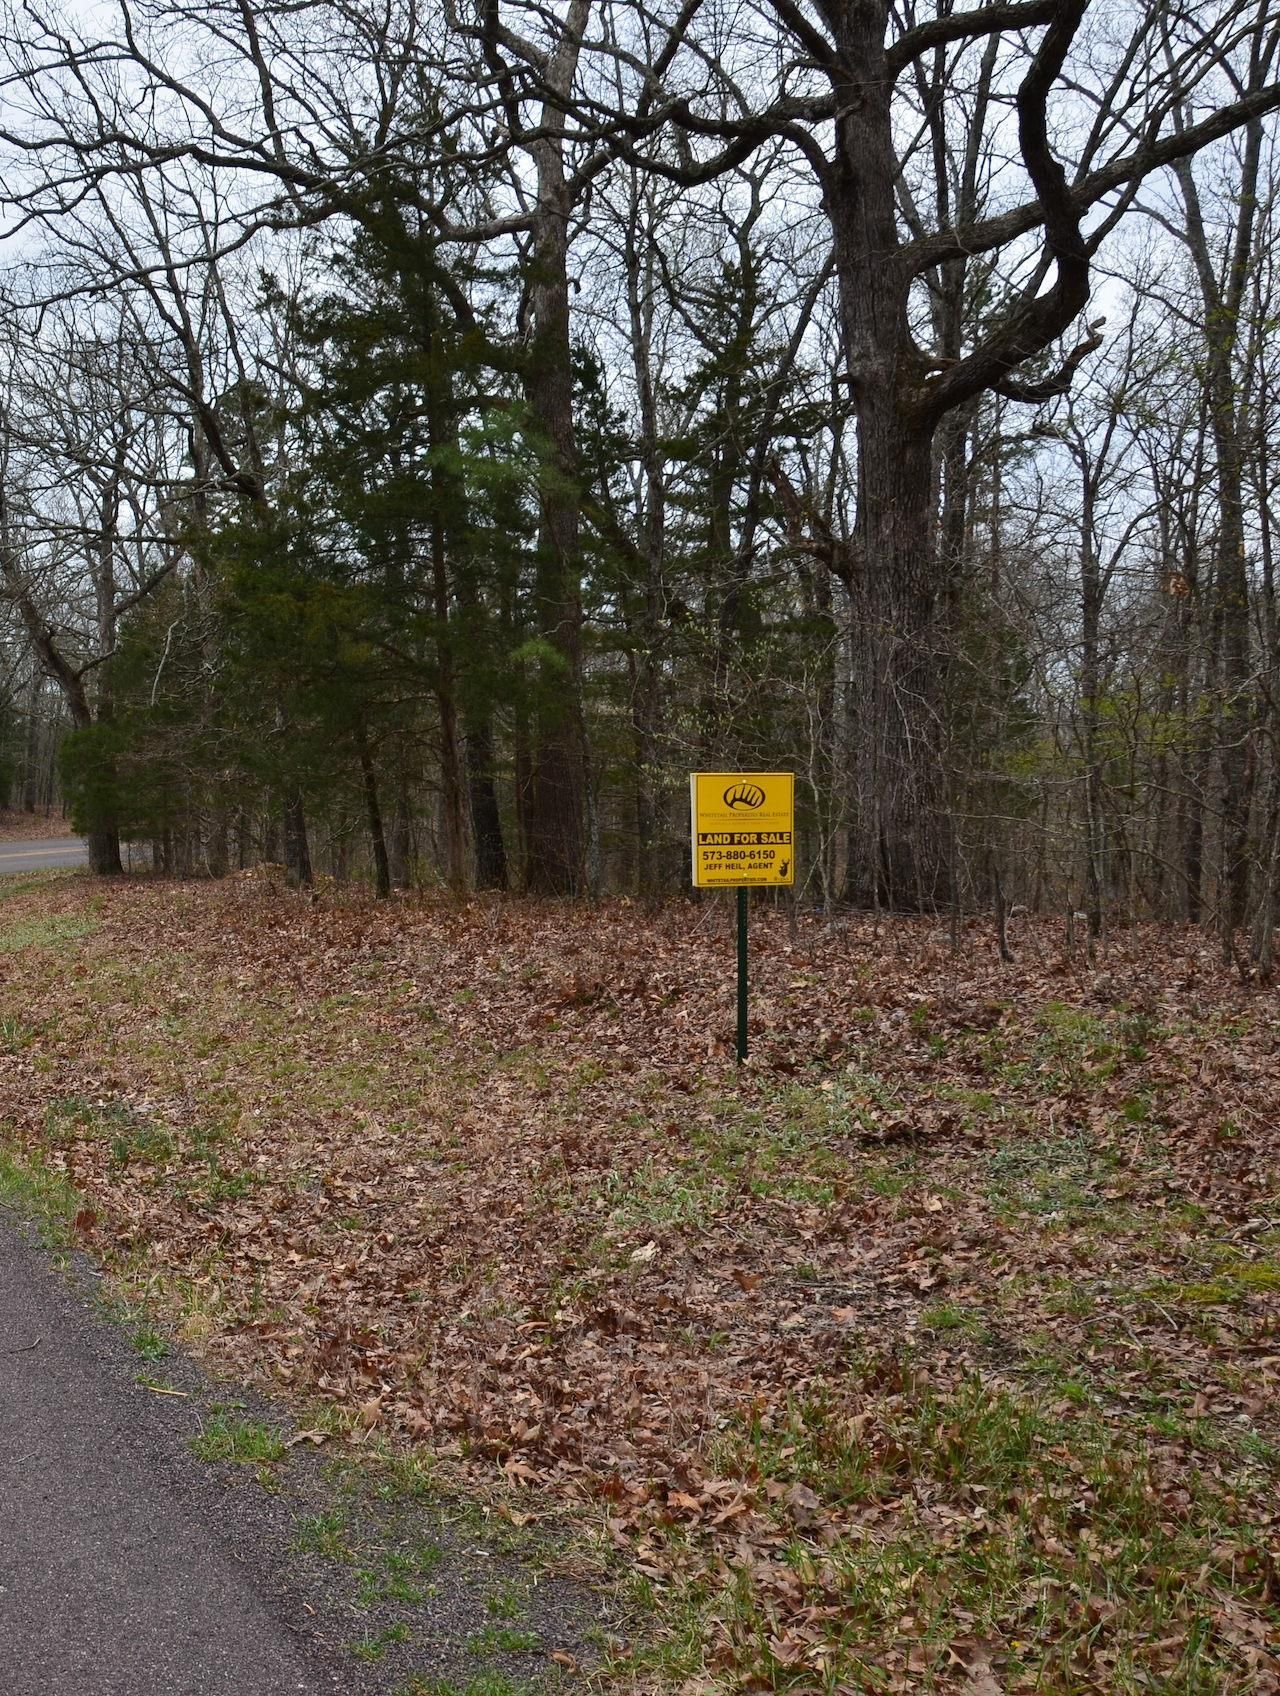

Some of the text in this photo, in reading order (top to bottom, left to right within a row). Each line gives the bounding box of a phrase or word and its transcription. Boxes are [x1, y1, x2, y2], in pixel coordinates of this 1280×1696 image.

[699, 833, 791, 844] LAND FOR SALE
[702, 850, 776, 861] 573-880-6150
[704, 862, 774, 871] JEFF HEIL, AGENT
